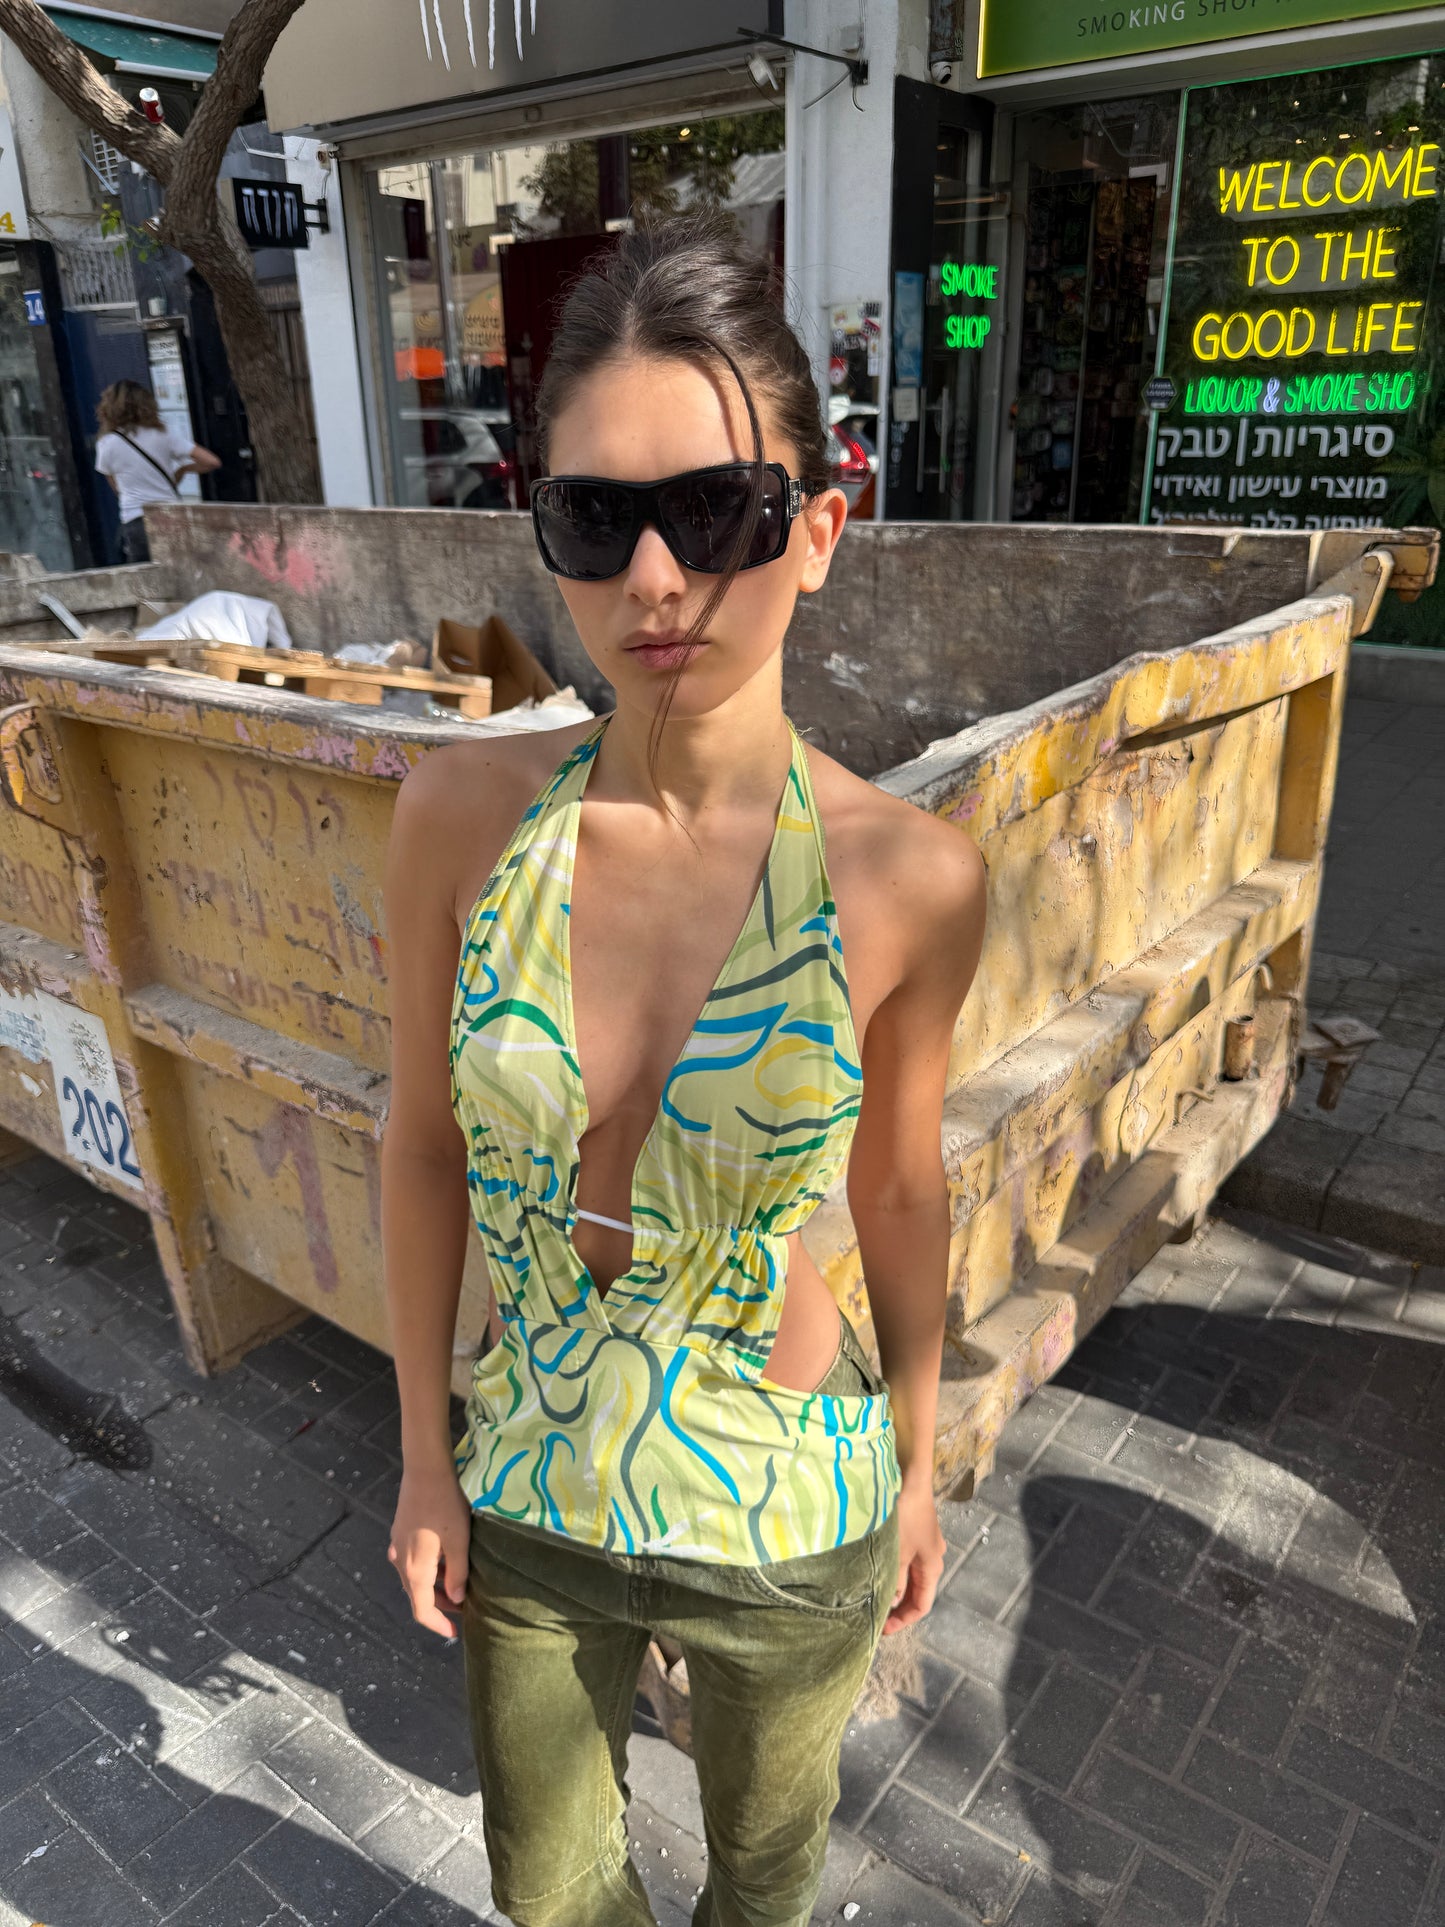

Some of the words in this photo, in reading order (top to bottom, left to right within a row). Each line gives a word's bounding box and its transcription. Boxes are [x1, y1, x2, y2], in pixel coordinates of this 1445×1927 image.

[1077, 1, 1186, 37] SMOKING
[1219, 144, 1440, 214] WELCOME
[0, 211, 17, 234] 4
[1242, 235, 1300, 287] TO
[1315, 226, 1402, 282] THE
[941, 263, 999, 299] SMOKE
[25, 299, 45, 321] 14
[945, 315, 991, 349] SHOP
[1193, 307, 1316, 361] GOOD
[1326, 301, 1423, 356] LIFE
[1184, 375, 1263, 413] LIQUOR
[1263, 377, 1280, 412] &
[1284, 372, 1365, 413] SMOKE
[1365, 371, 1416, 411] SHO
[1156, 426, 1232, 467] טבק
[1251, 424, 1395, 459] סיגריות
[1153, 475, 1220, 497] ואידוי
[1228, 475, 1302, 503] עישון
[1310, 475, 1388, 499] מוצרי
